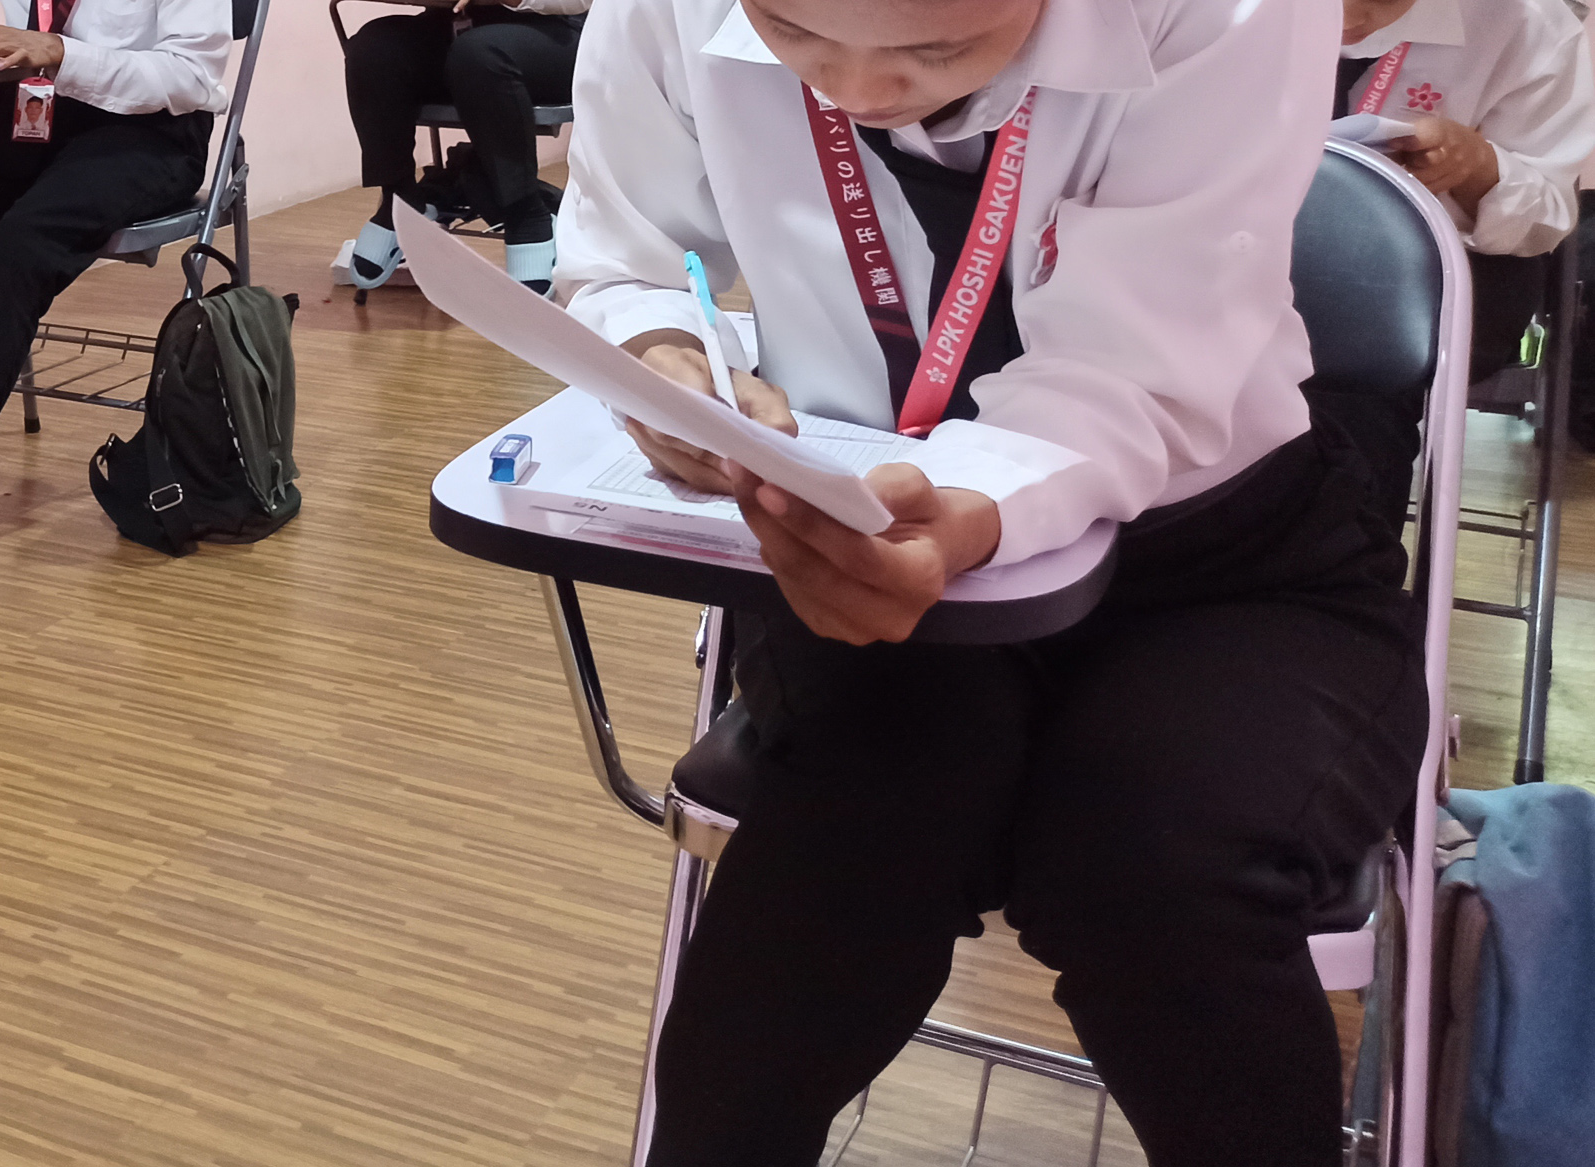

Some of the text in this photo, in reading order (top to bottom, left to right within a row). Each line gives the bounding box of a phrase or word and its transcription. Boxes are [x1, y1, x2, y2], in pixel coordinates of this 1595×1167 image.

[932, 320, 965, 366] LPK
[950, 248, 995, 324] HOSHI
[979, 135, 1027, 246] GAKUEN
